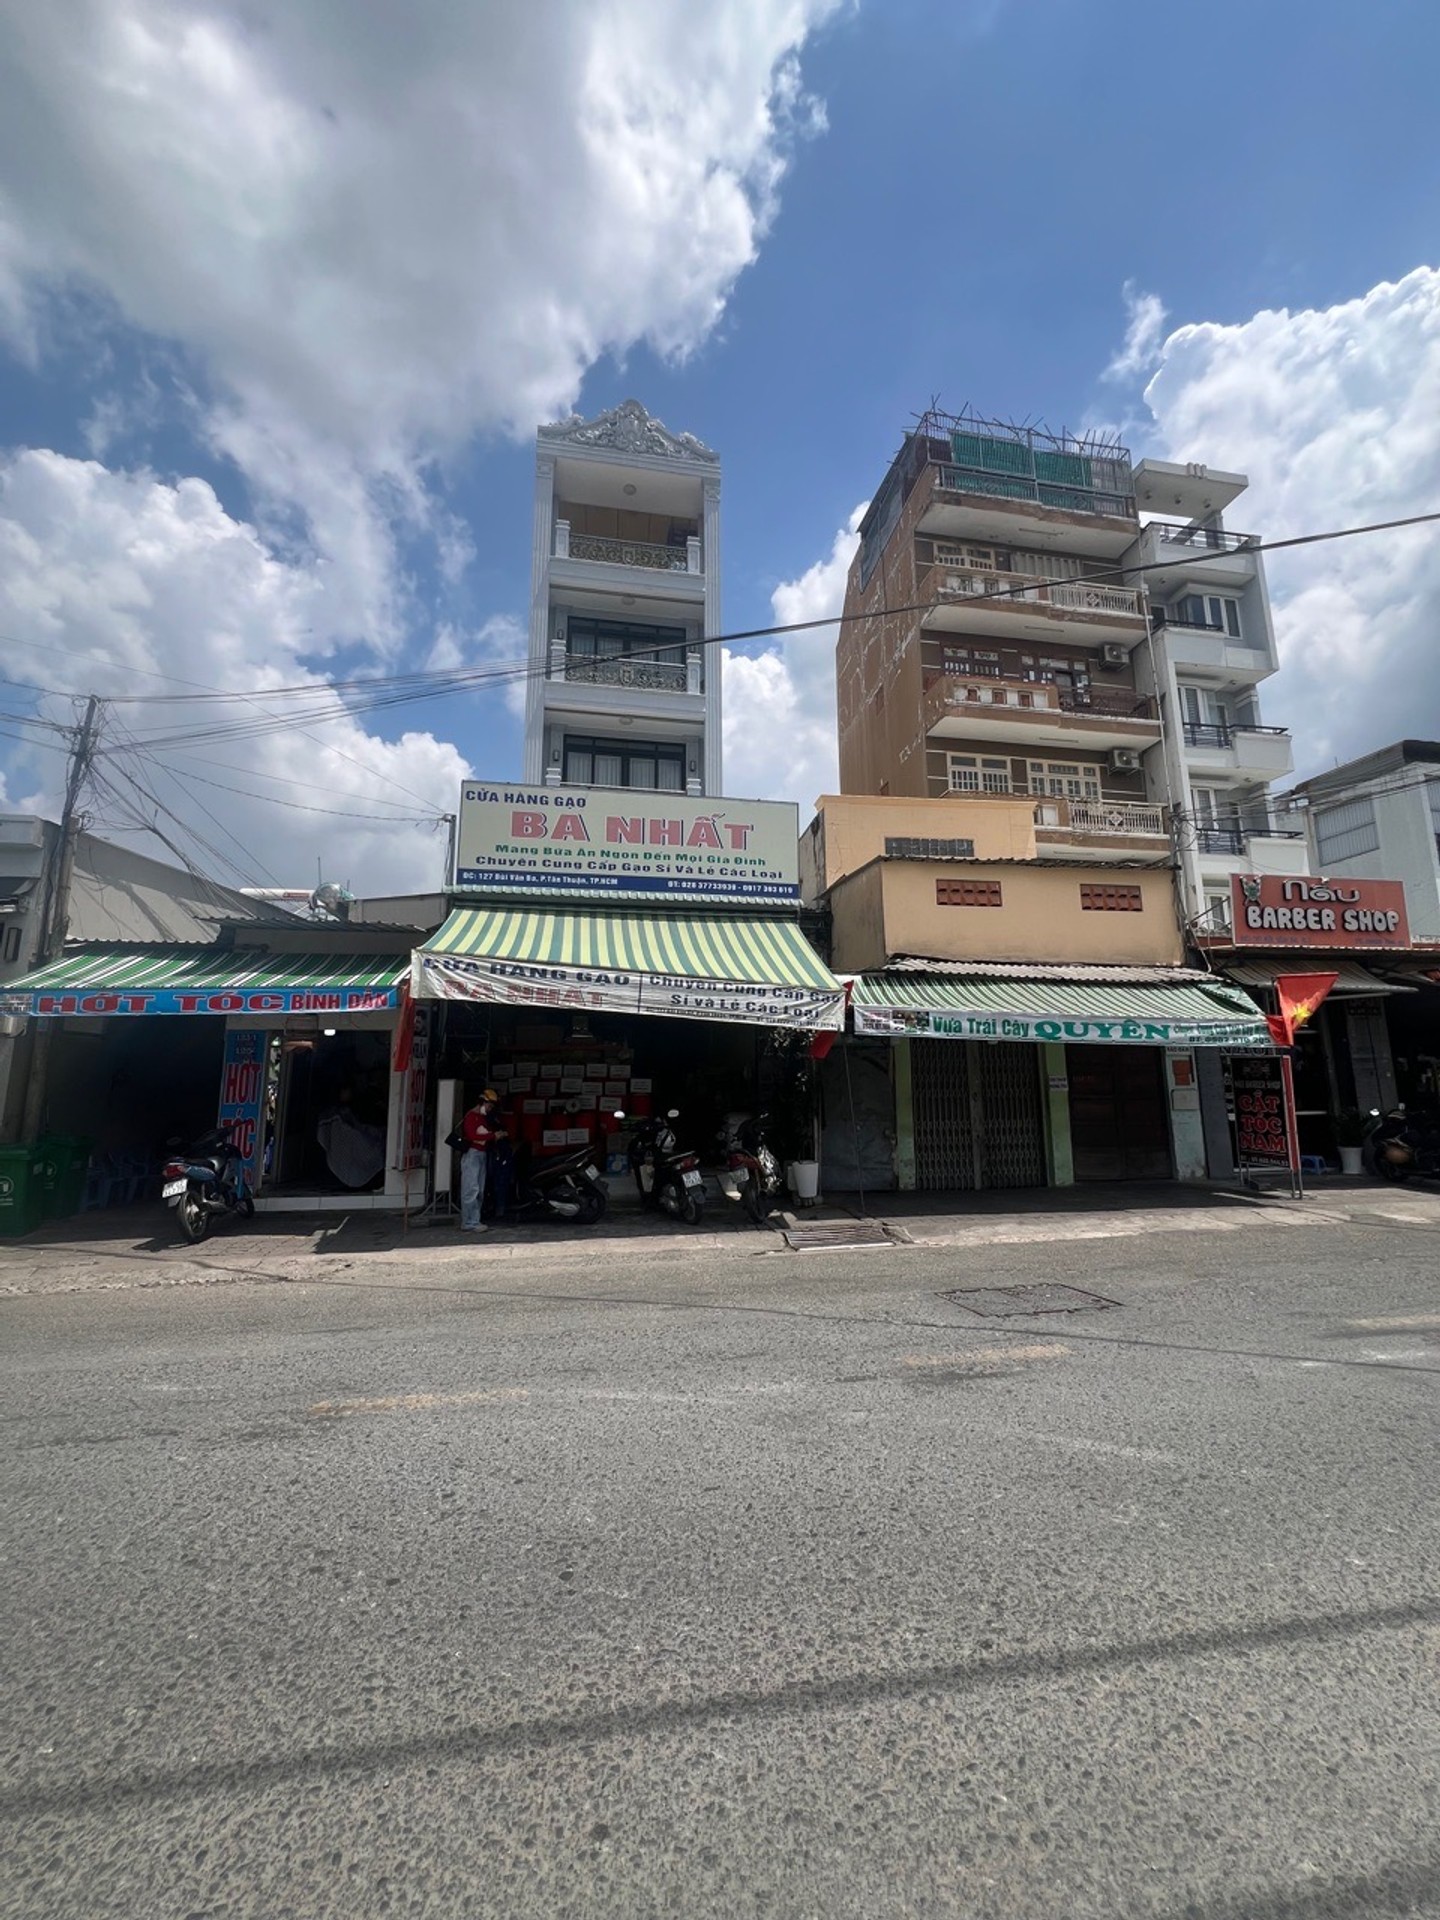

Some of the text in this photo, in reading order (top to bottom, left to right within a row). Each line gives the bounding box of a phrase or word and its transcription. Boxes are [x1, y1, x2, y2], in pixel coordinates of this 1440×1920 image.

[466, 787, 587, 810] CỬA HÀNG GẠO
[511, 811, 755, 850] BA NHẤT
[495, 844, 539, 855] Mang
[600, 849, 639, 860] Ngon
[675, 852, 702, 863] Mọi
[707, 855, 730, 865] Gia
[476, 855, 537, 867] Chuyên
[542, 858, 582, 870] Cung
[587, 860, 617, 872] Cấp
[621, 862, 651, 874] Gạo
[719, 867, 747, 878] Các
[751, 869, 783, 881] Loại
[479, 872, 493, 881] 127
[1246, 906, 1400, 933] BARBER SHOP
[37, 991, 156, 1014] HỚT
[173, 989, 285, 1012] TÓC
[290, 990, 341, 1011] BÌNH
[723, 982, 767, 998] Cung
[746, 1001, 778, 1014] Các
[932, 1014, 963, 1037] Vựa
[967, 1016, 997, 1036] Trái
[1002, 1017, 1030, 1038] Cây
[1034, 1019, 1172, 1041] QUYÊN
[1240, 1112, 1282, 1135] TÓC
[1239, 1131, 1287, 1154] NAM
